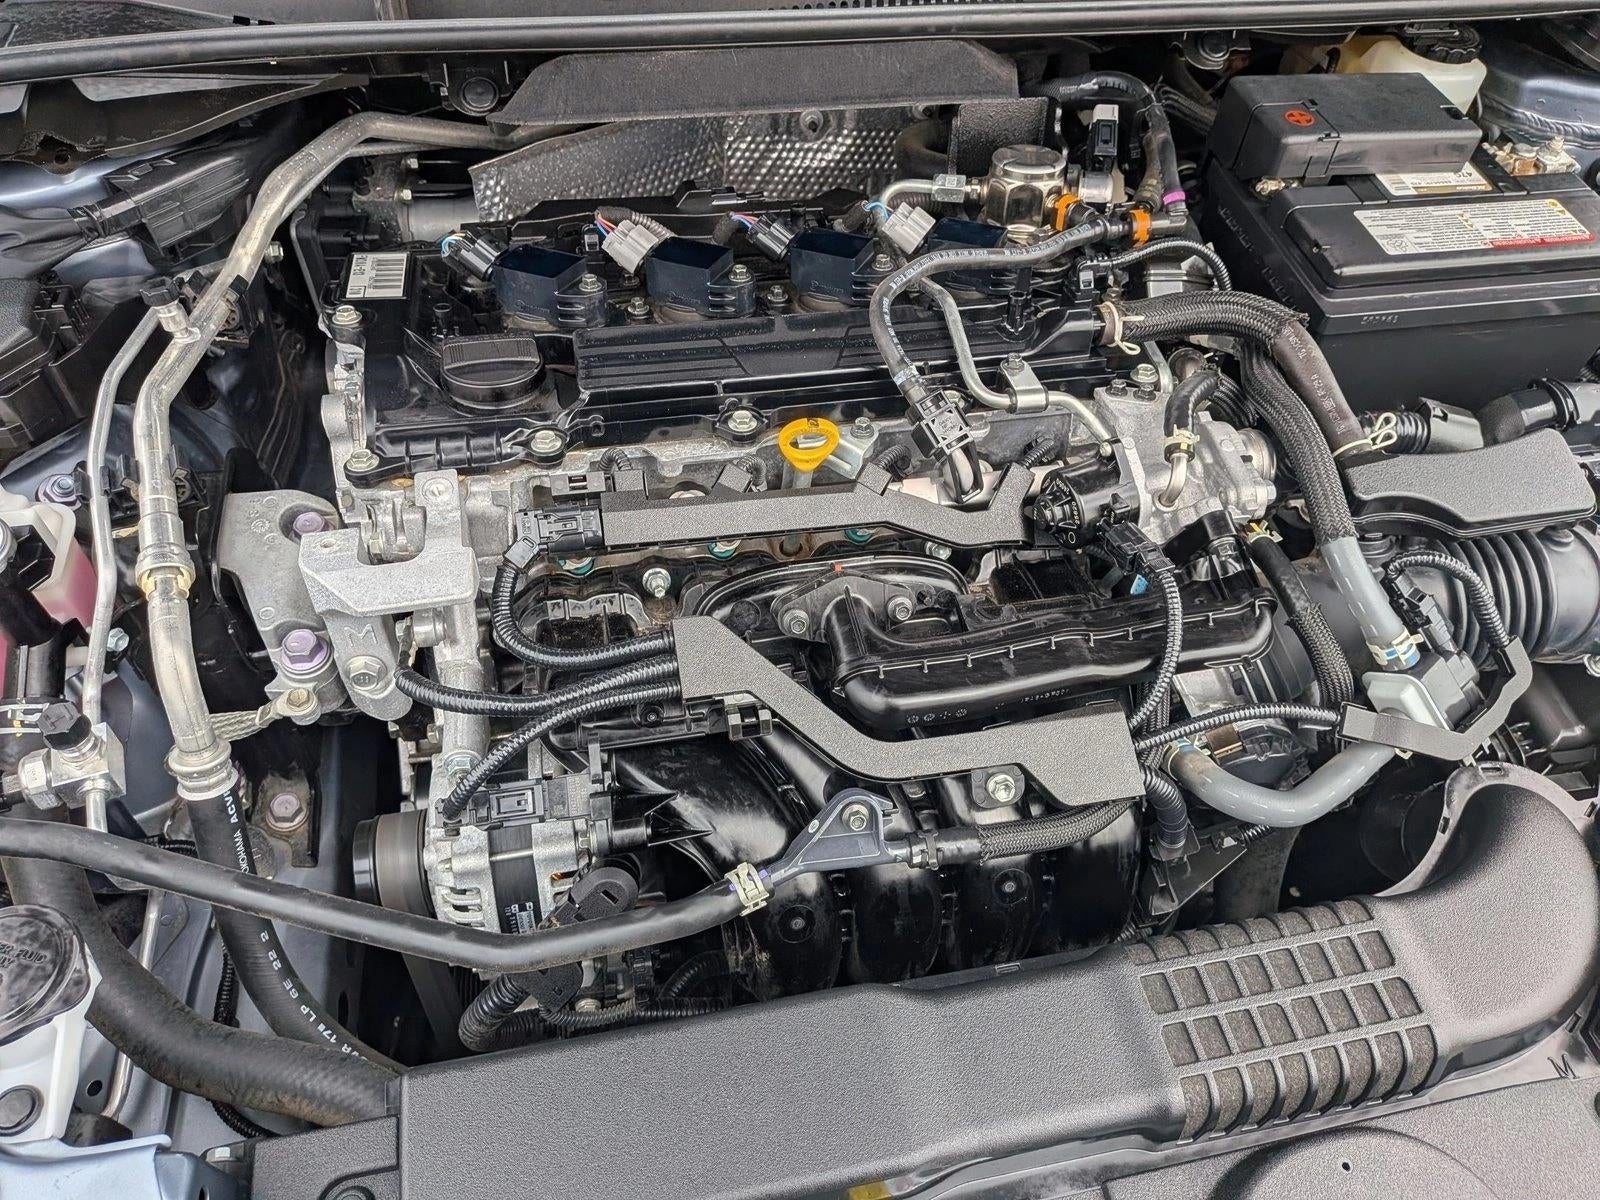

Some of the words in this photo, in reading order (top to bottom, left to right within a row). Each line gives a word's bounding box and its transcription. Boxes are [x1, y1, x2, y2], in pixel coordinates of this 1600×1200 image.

[344, 623, 379, 647] M
[233, 829, 250, 873] OKOHAMA
[16, 949, 47, 965] FLUID
[268, 949, 283, 970] 22
[300, 1004, 317, 1022] LP
